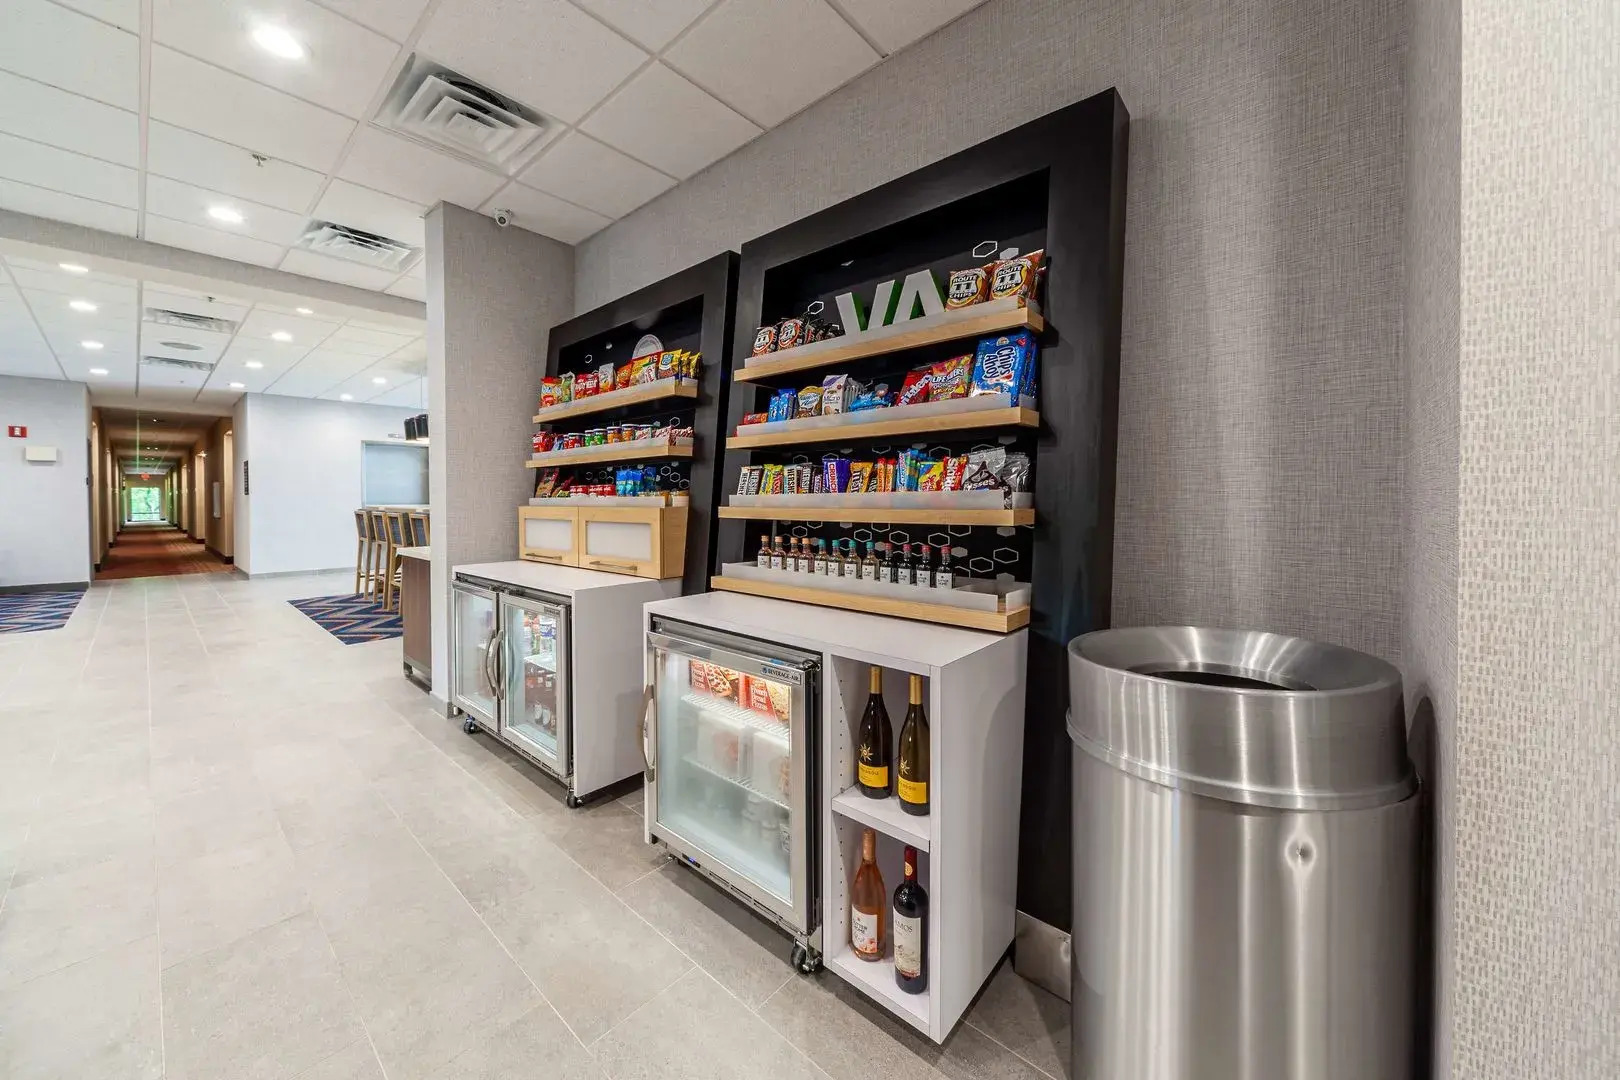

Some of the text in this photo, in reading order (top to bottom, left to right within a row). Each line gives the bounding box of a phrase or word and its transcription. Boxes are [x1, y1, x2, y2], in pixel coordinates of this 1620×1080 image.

[998, 265, 1023, 277] ROUTE
[952, 274, 978, 283] ROUTE
[953, 283, 973, 291] 11
[996, 346, 1015, 375] Chips
